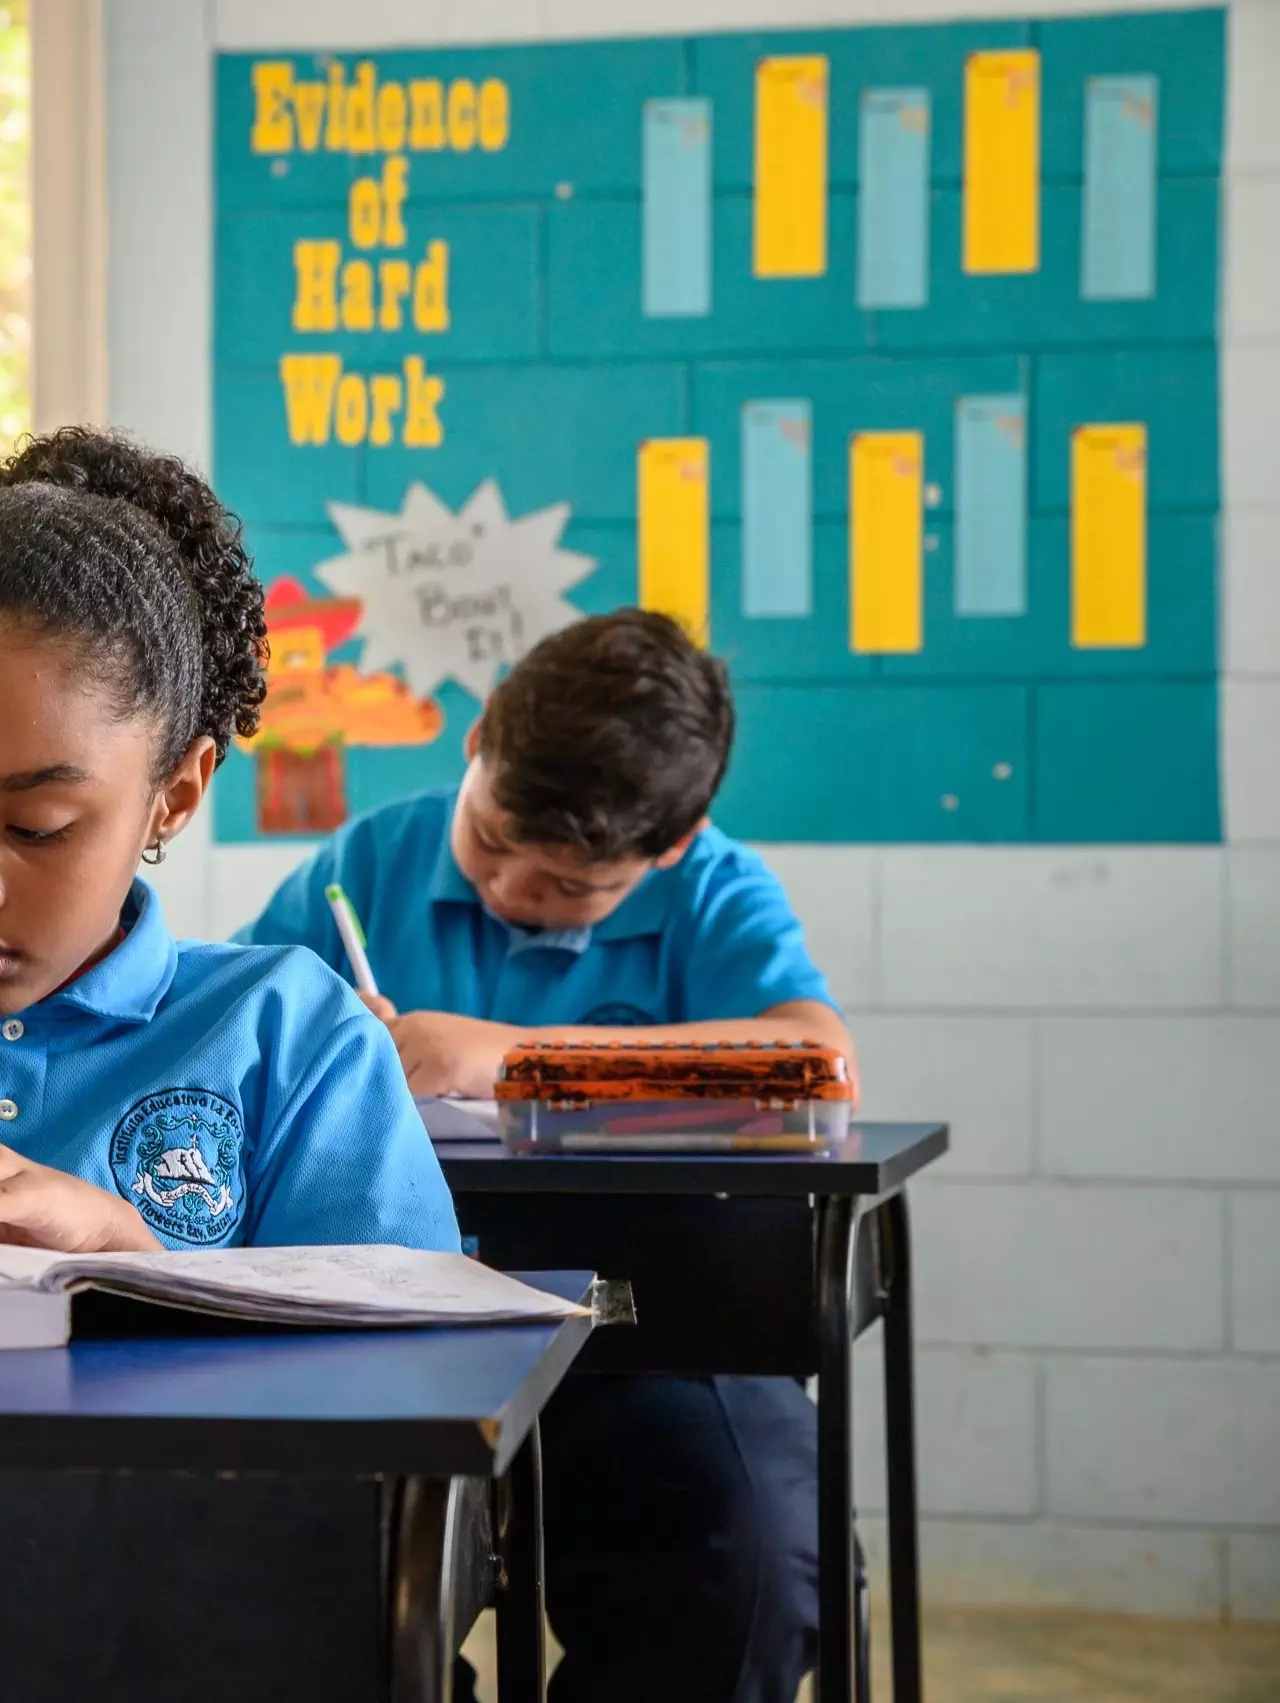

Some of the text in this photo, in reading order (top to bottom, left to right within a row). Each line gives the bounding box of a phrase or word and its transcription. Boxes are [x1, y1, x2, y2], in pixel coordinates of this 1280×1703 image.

[252, 60, 510, 154] Evidence
[349, 154, 409, 249] of
[292, 239, 450, 333] Hard
[280, 353, 445, 448] Work
[112, 1113, 145, 1165] Instituto
[141, 1094, 208, 1117] Educativo
[210, 1099, 225, 1116] La
[137, 1200, 185, 1234] Flowers
